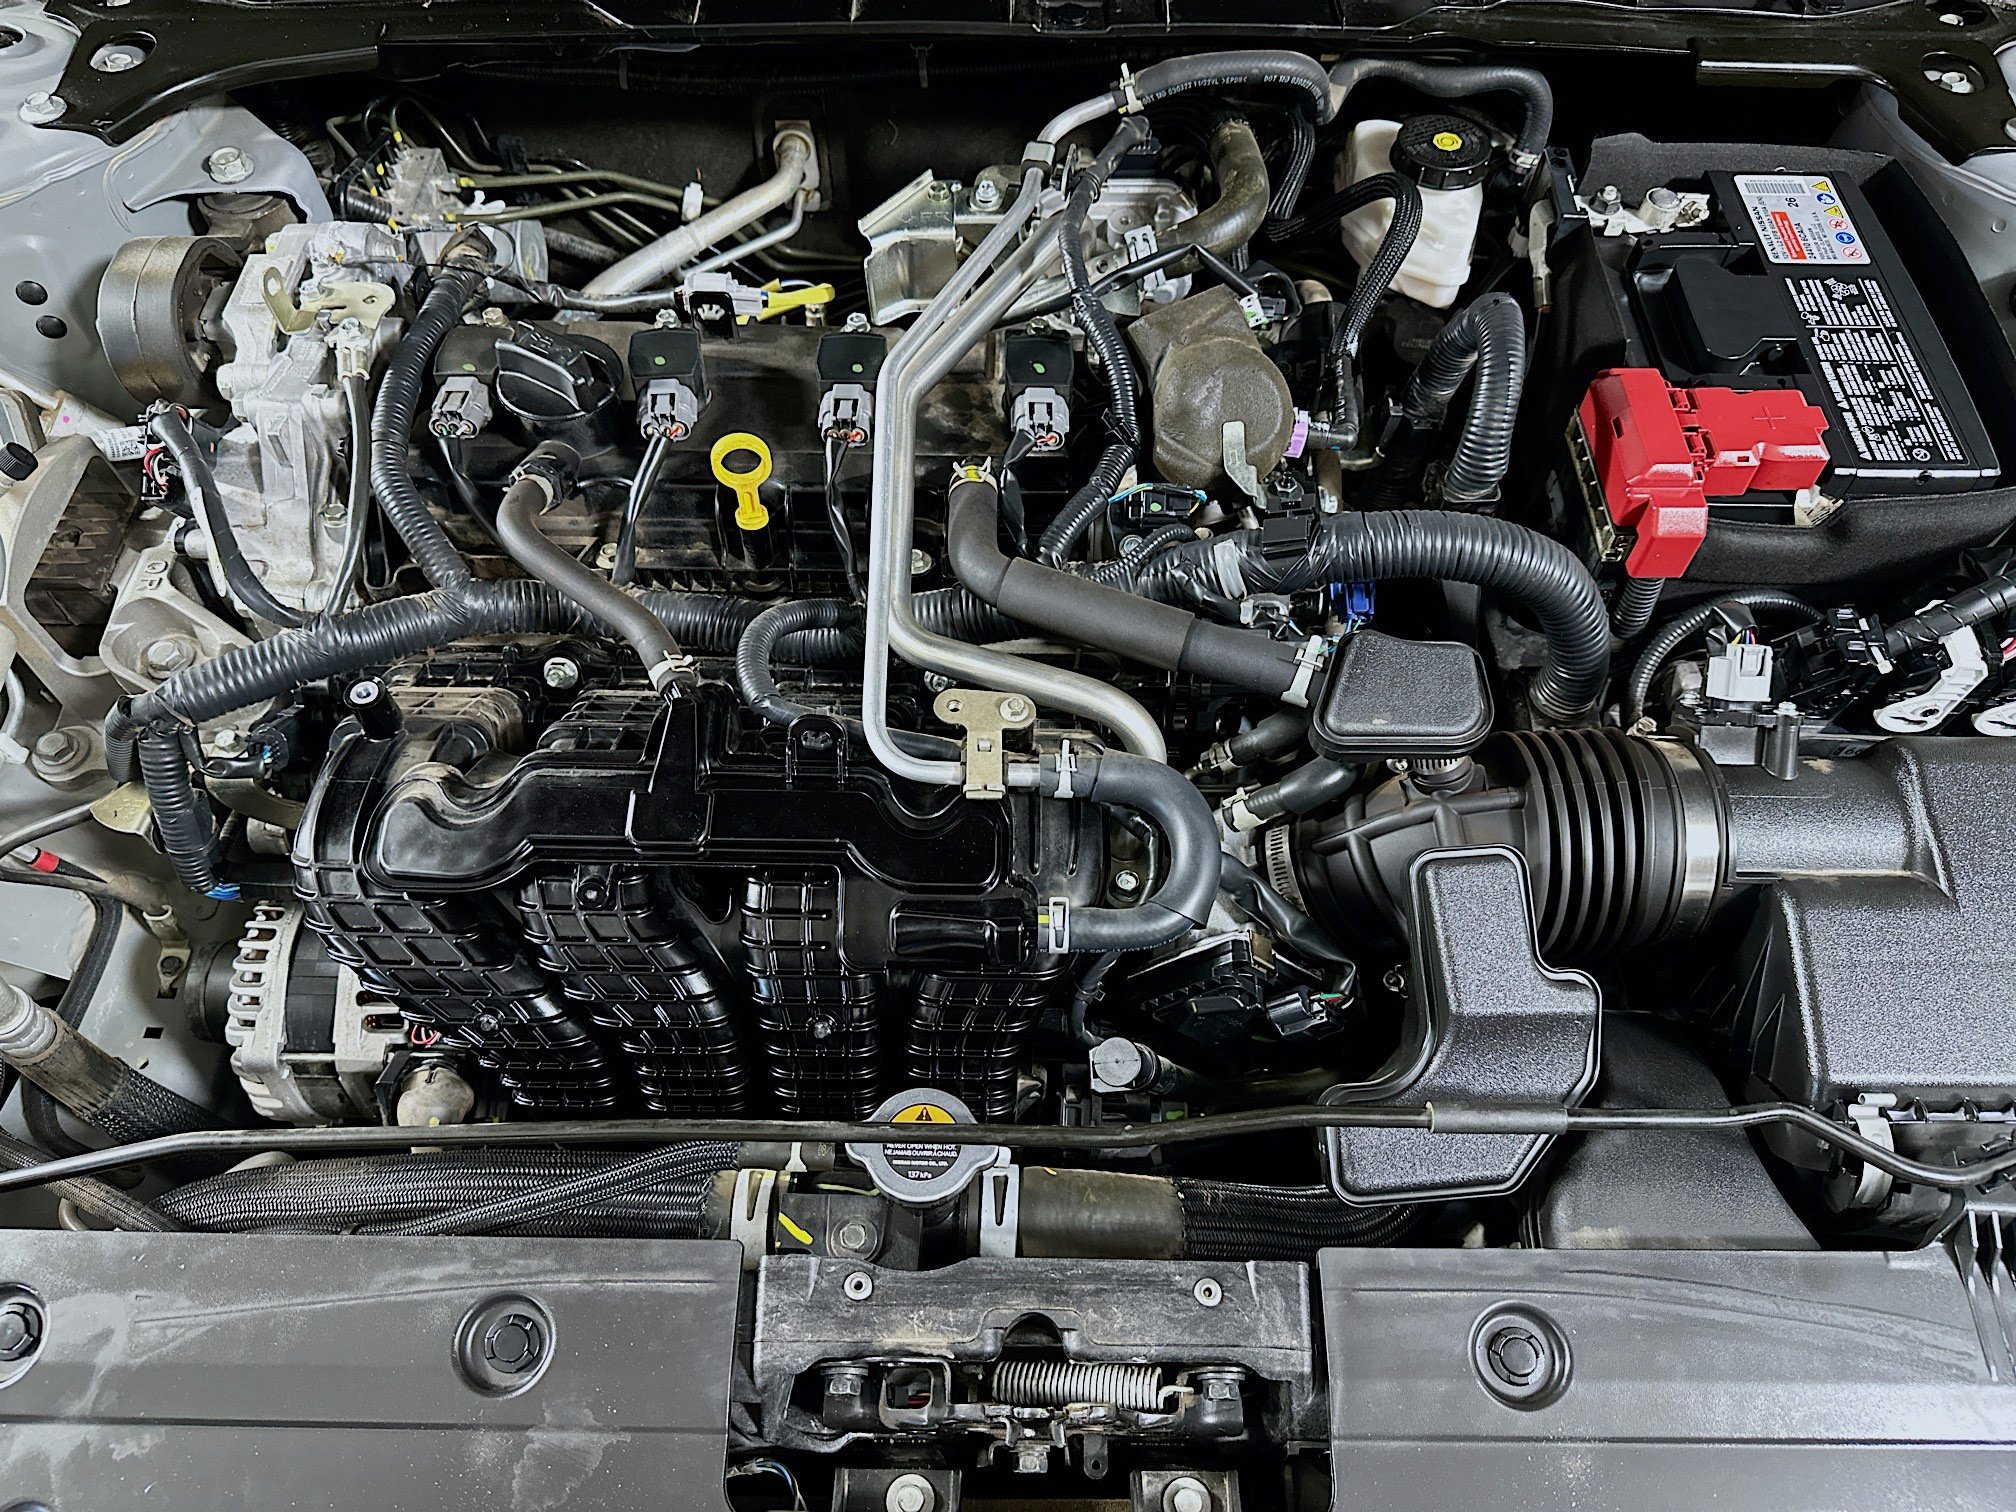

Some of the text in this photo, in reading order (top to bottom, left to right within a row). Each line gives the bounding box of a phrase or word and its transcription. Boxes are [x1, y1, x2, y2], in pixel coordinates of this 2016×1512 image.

[1785, 197, 1799, 207] 26
[1752, 206, 1780, 259] RENAULT NISSAN
[1803, 242, 1817, 259] 24410
[907, 1170, 932, 1179] 137 kPa
